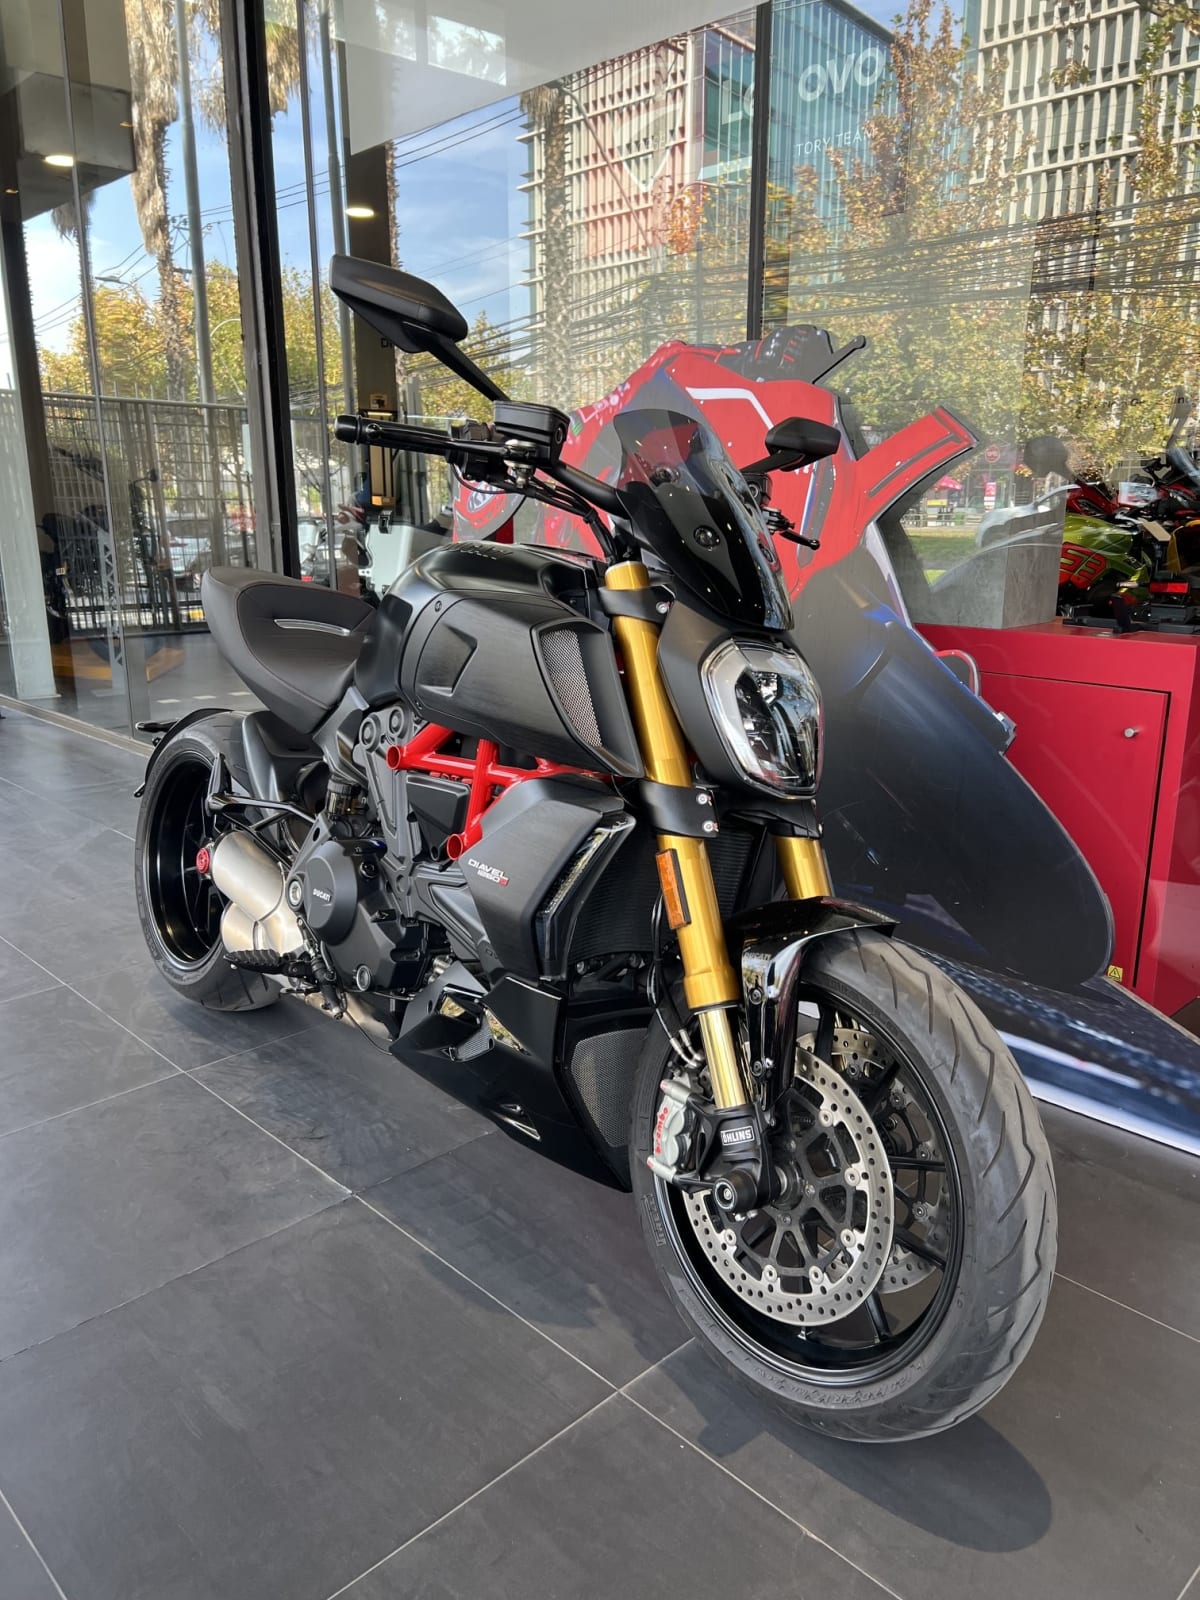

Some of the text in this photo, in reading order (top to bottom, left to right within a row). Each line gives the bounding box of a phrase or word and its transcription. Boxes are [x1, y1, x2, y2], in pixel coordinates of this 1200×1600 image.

[468, 858, 509, 880] DIAVEL
[312, 888, 331, 902] DUCATI
[655, 1107, 669, 1154] brembo
